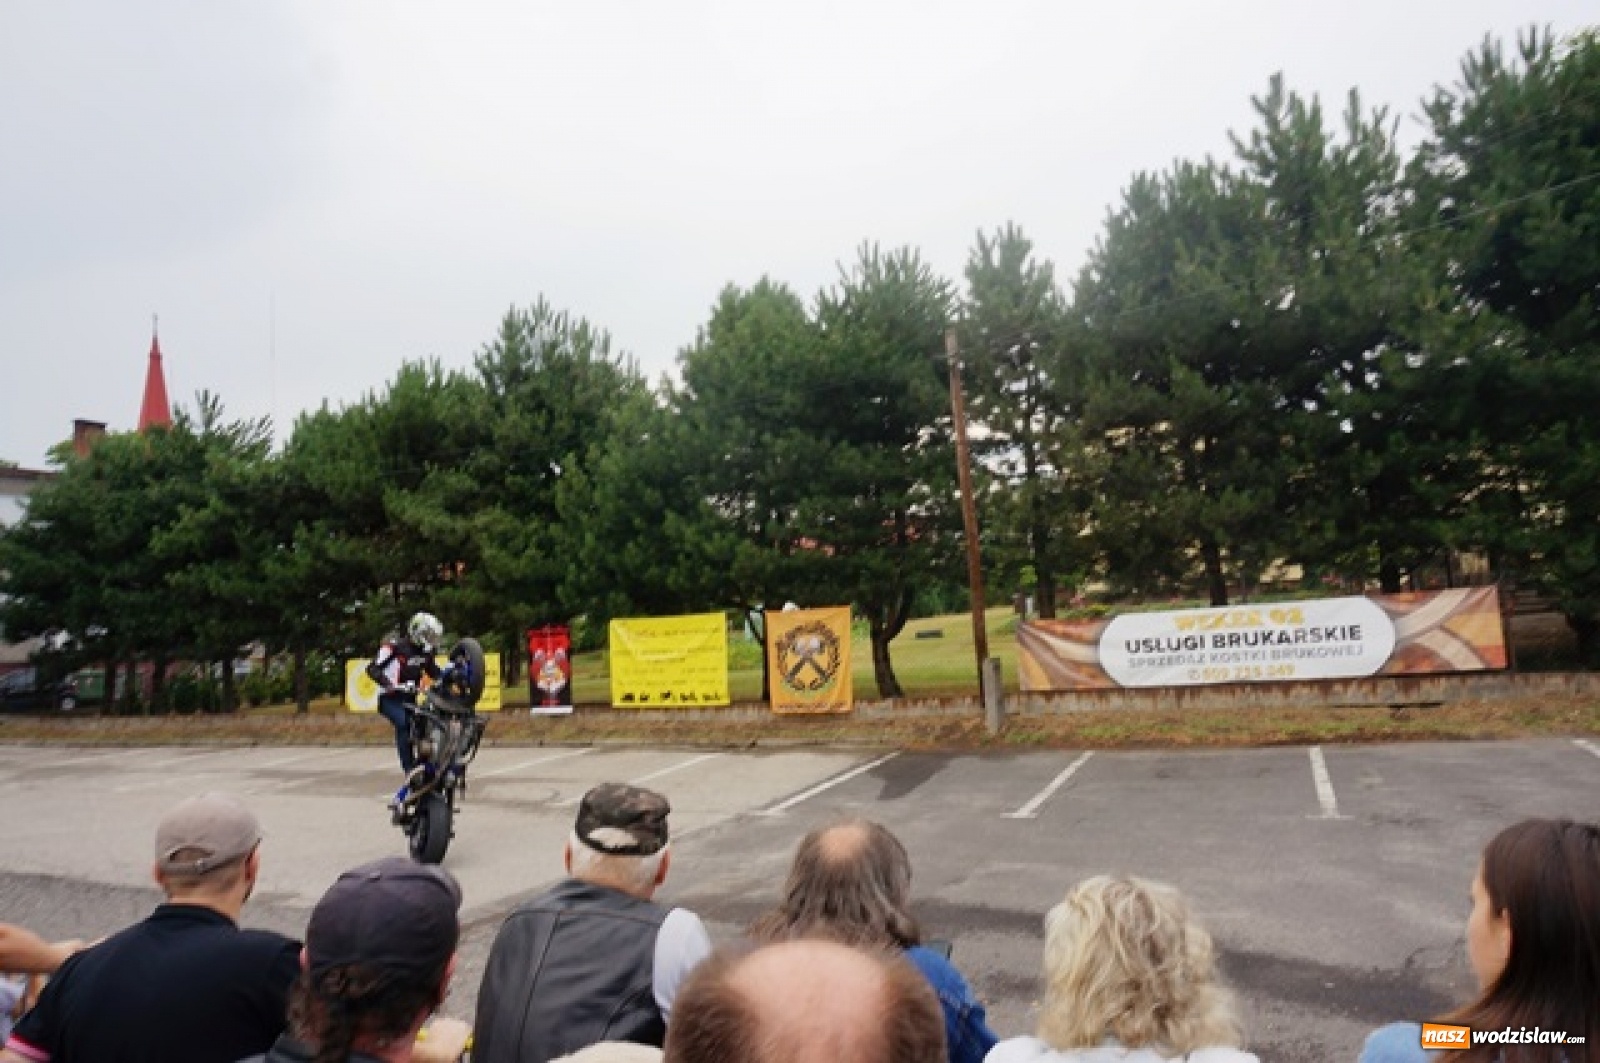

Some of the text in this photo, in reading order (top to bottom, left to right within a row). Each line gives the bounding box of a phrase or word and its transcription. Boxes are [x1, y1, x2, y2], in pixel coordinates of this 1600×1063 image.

[1211, 624, 1363, 648] BRUKARSKIE
[1209, 648, 1266, 664] KOSTKI
[1270, 644, 1364, 661] BRUKOWEJ
